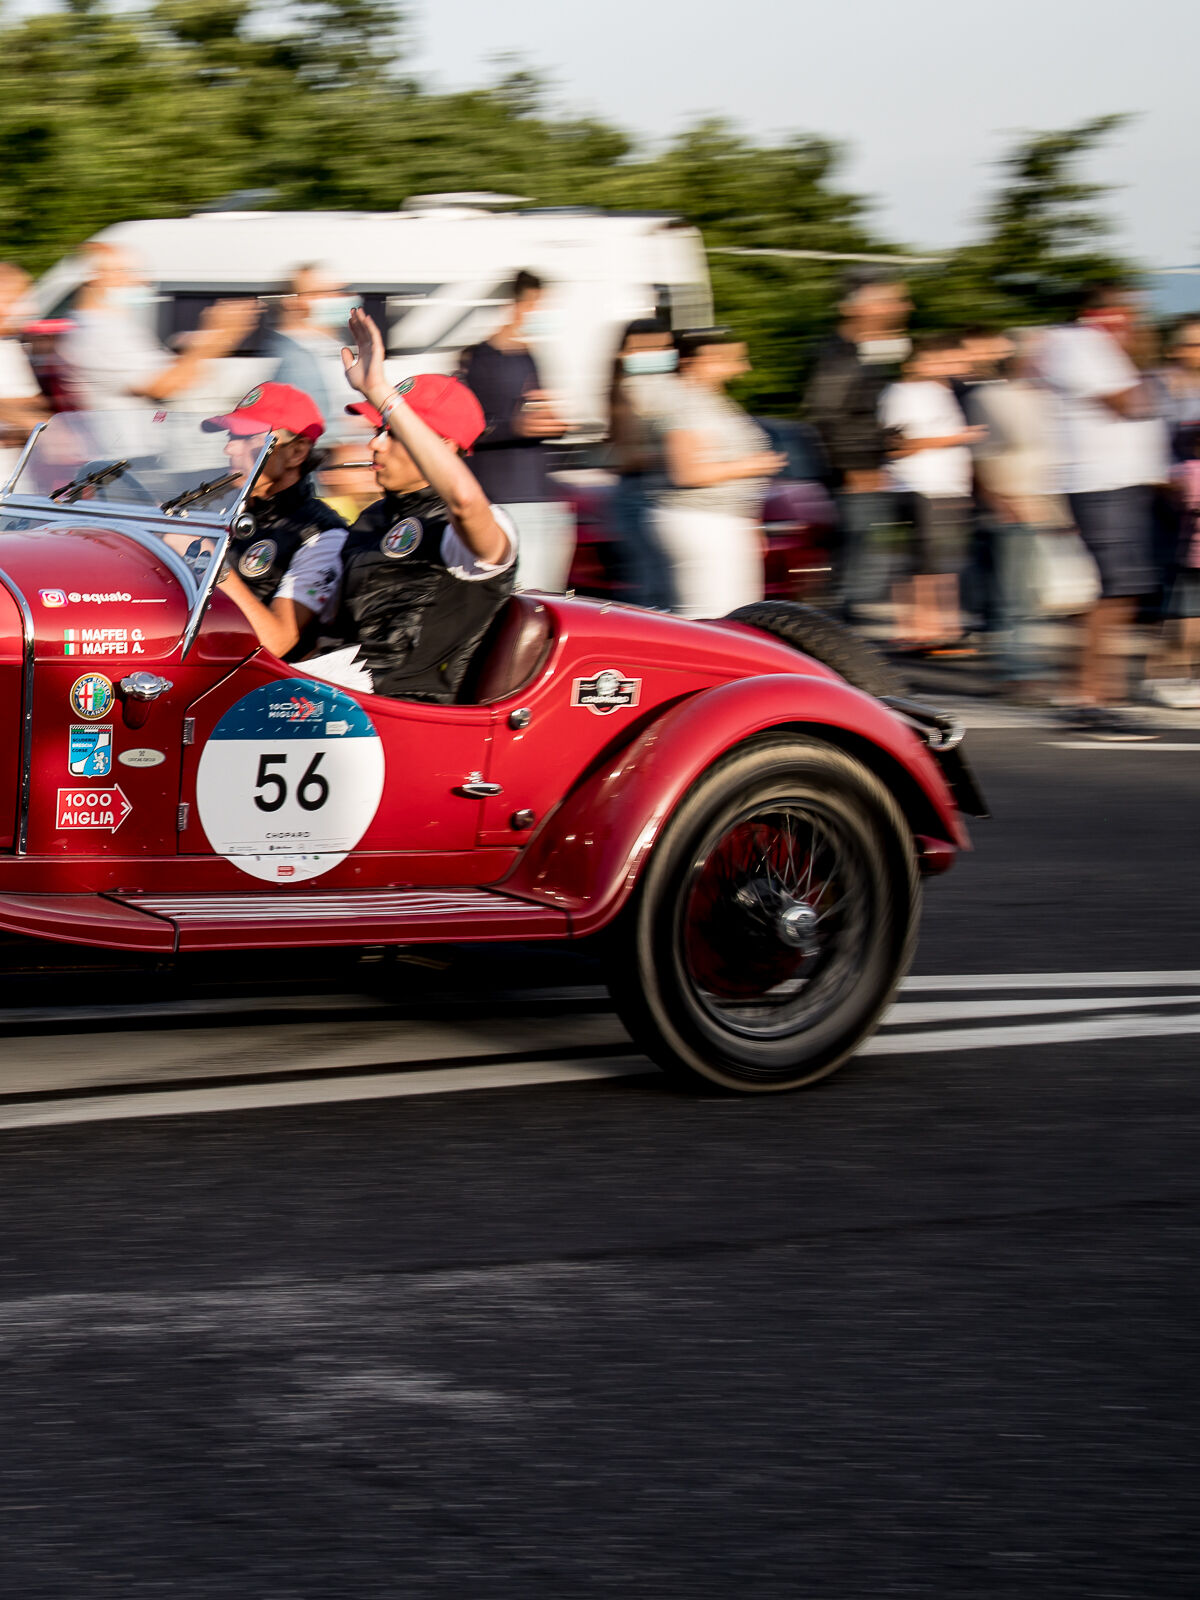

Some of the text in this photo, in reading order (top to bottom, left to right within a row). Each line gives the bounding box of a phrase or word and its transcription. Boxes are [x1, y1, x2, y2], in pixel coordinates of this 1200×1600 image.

[81, 628, 146, 642] MAFFEI G.
[82, 642, 145, 655] MAFFEI A.
[79, 705, 106, 717] MILANO
[253, 751, 330, 813] 56
[65, 793, 112, 807] 1000
[60, 811, 114, 825] MIGLIA
